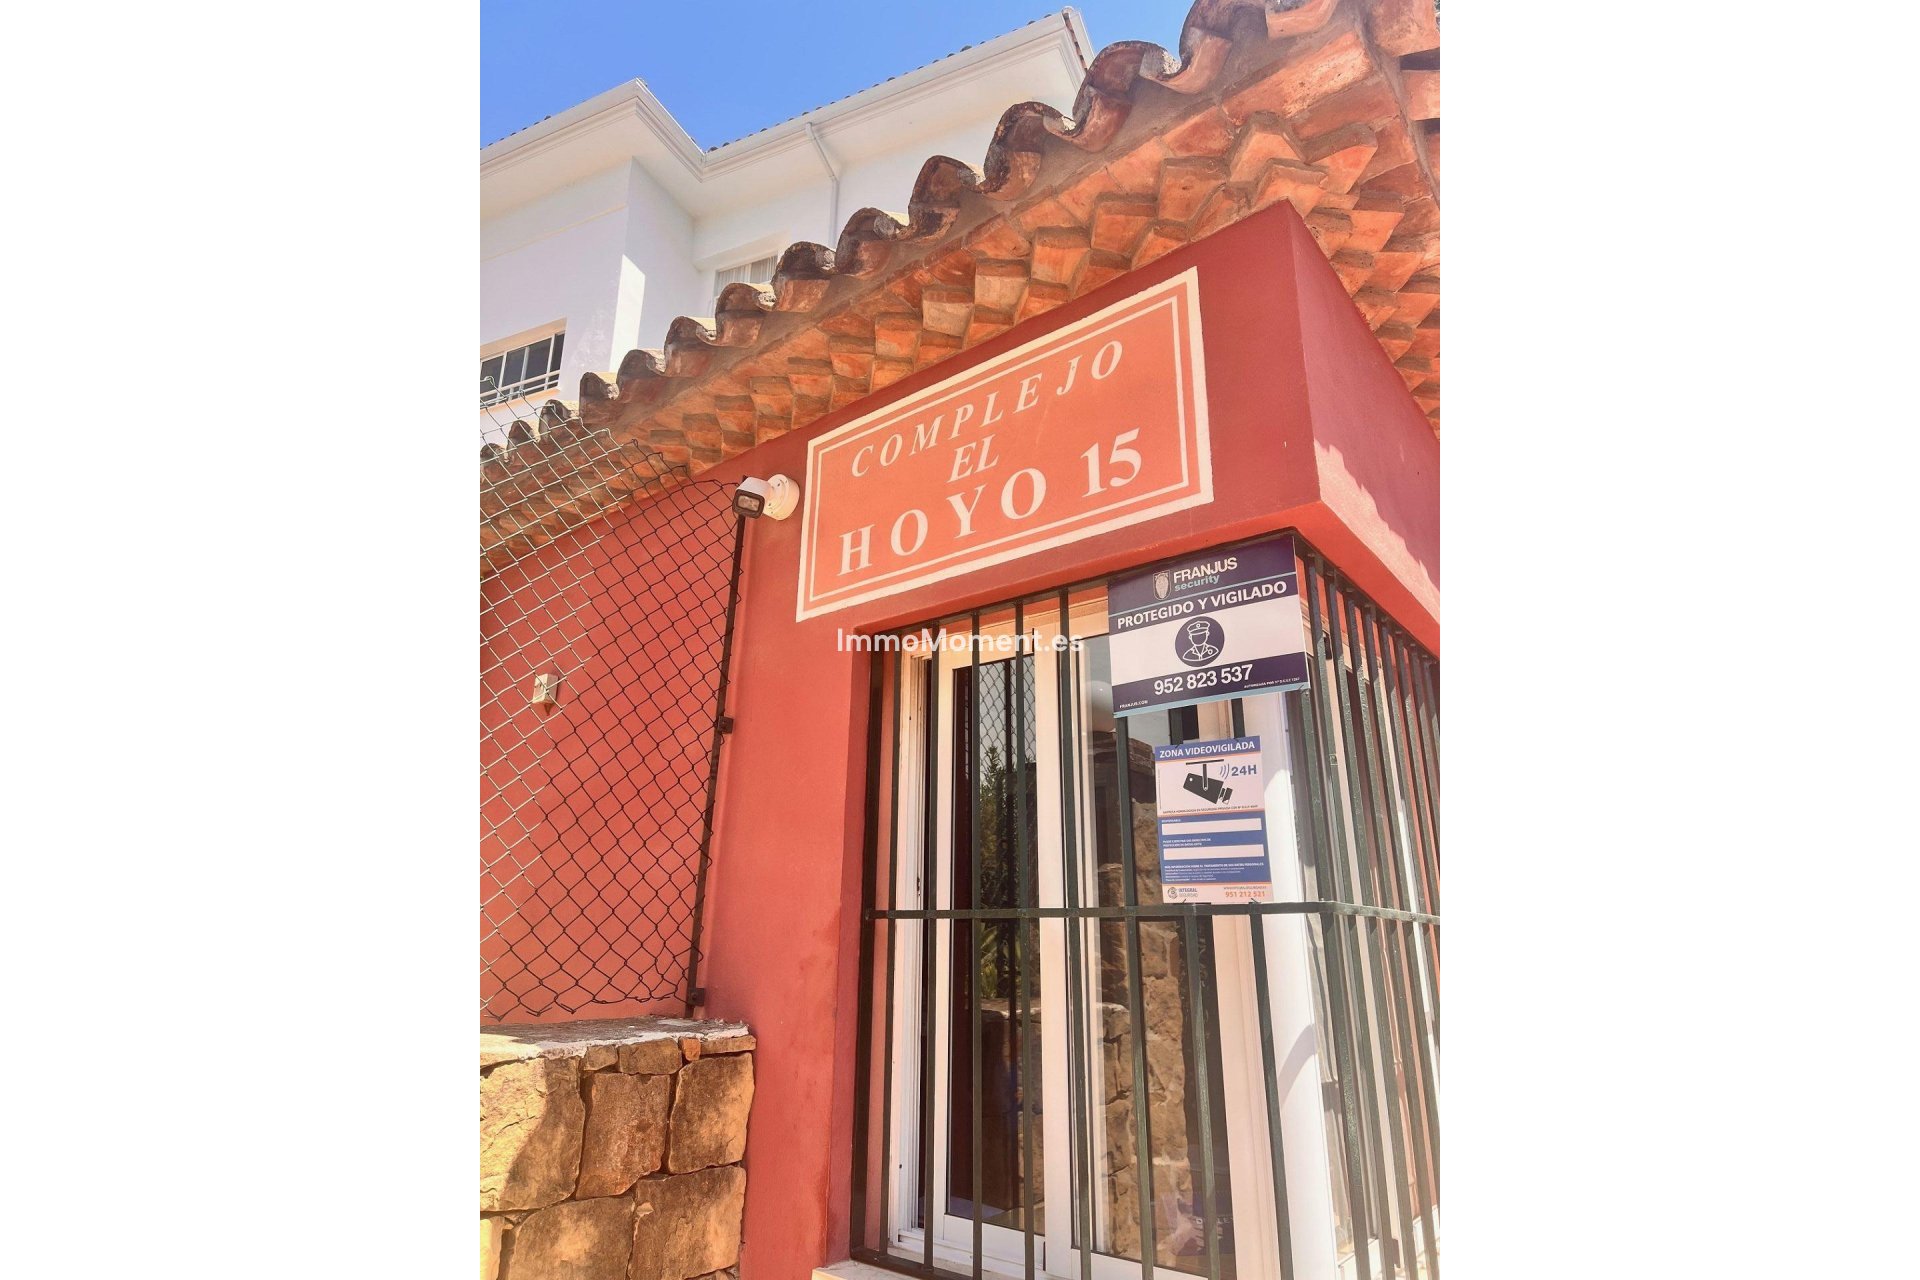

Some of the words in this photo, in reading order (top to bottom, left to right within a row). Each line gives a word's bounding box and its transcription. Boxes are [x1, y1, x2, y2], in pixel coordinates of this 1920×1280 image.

[851, 340, 1123, 477] COMPLEJO
[946, 434, 1000, 484] EL
[837, 467, 1047, 577] HOYO
[1080, 427, 1143, 498] 15
[1173, 556, 1238, 584] FRANJUS
[1174, 573, 1221, 592] security
[1117, 601, 1194, 630] PROTEGIDO
[1197, 598, 1209, 611] Y
[1210, 581, 1287, 608] VIGILADO
[1153, 676, 1184, 696] 952
[1186, 670, 1218, 690] 823
[1220, 664, 1253, 685] 537
[1119, 699, 1149, 709] FRANJUS.COM
[1159, 747, 1184, 758] ZONA
[1185, 740, 1255, 756] VIDEOVIGILADA
[1231, 764, 1257, 777] 24H
[1225, 890, 1238, 898] 951
[1239, 890, 1252, 898] 212
